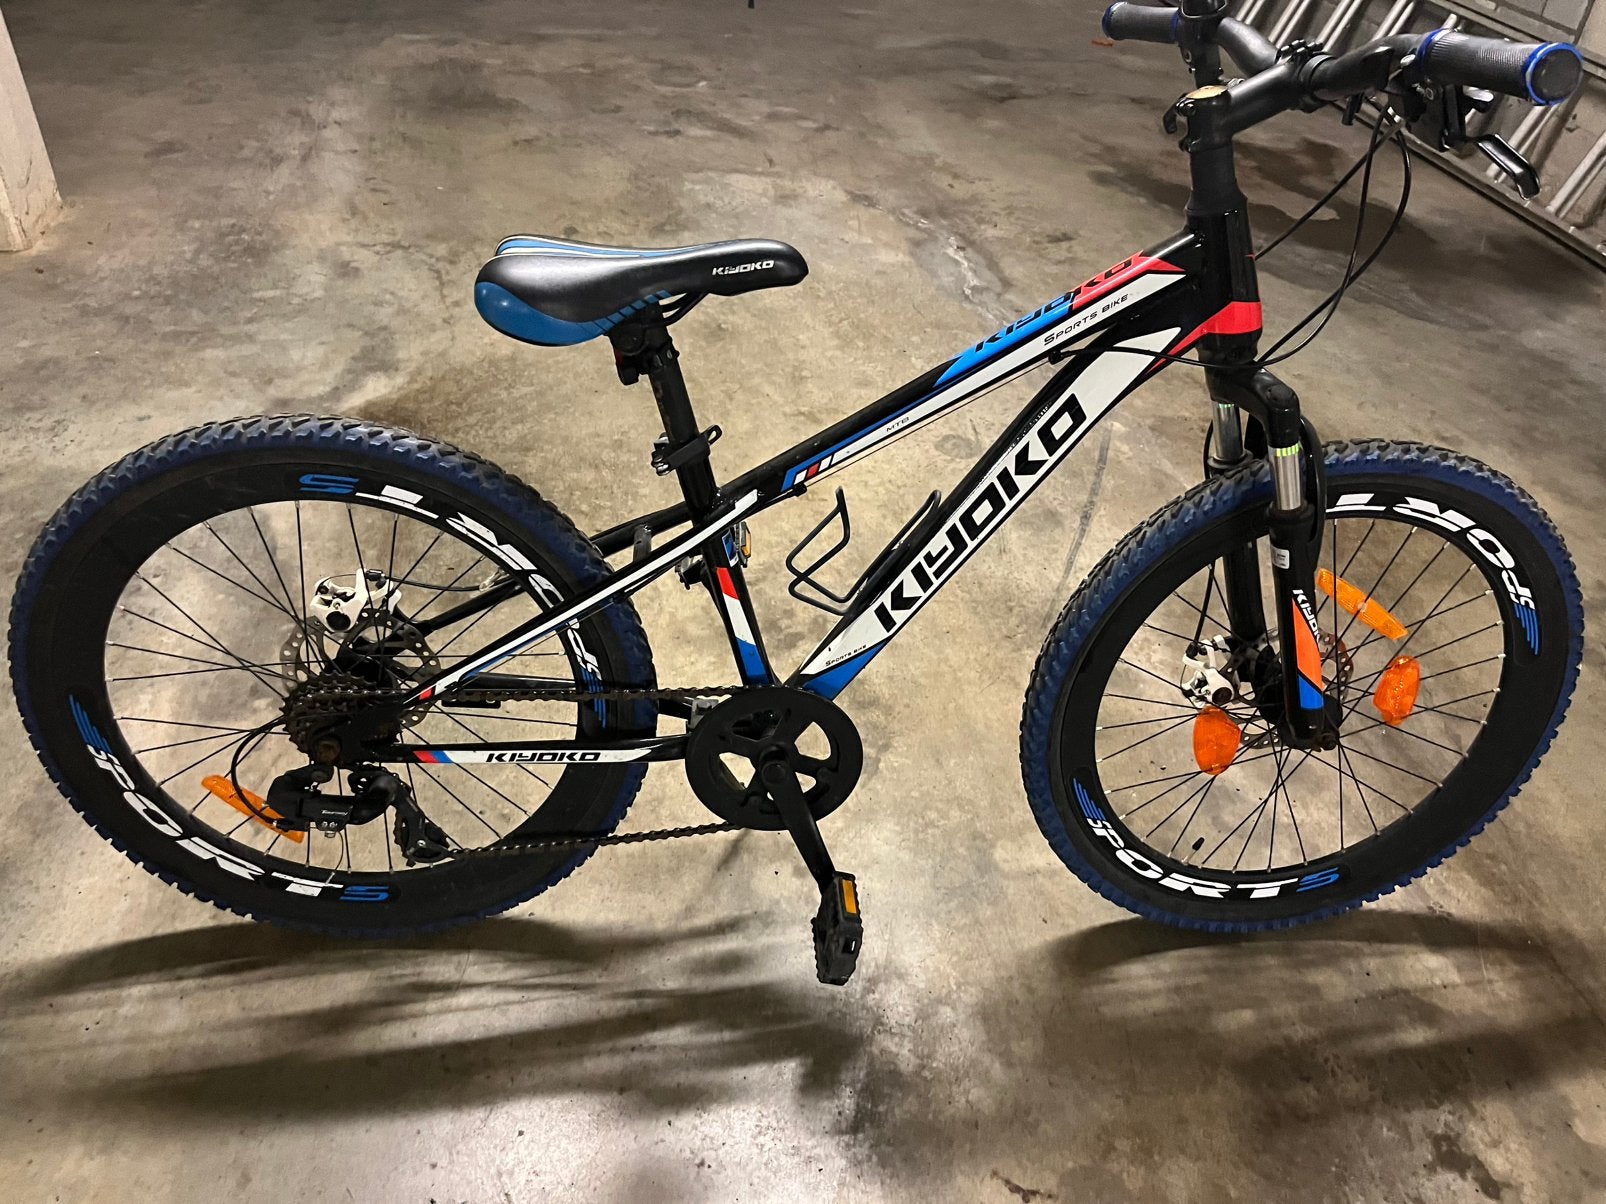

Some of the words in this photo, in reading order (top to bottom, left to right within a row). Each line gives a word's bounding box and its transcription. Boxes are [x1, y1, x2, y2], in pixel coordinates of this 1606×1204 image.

[712, 260, 775, 276] KIYOKO
[975, 258, 1133, 353] KIYOKO
[1044, 311, 1098, 346] SPORTS
[1101, 293, 1129, 313] BIKE
[886, 416, 910, 432] MTB
[874, 393, 1087, 633] KIYOKO
[1326, 493, 1536, 610] SPORT
[1292, 589, 1321, 643] KIYOK
[486, 752, 601, 763] KIYOKO
[87, 744, 390, 901] SPORTS
[1086, 818, 1341, 899] SPORTS
